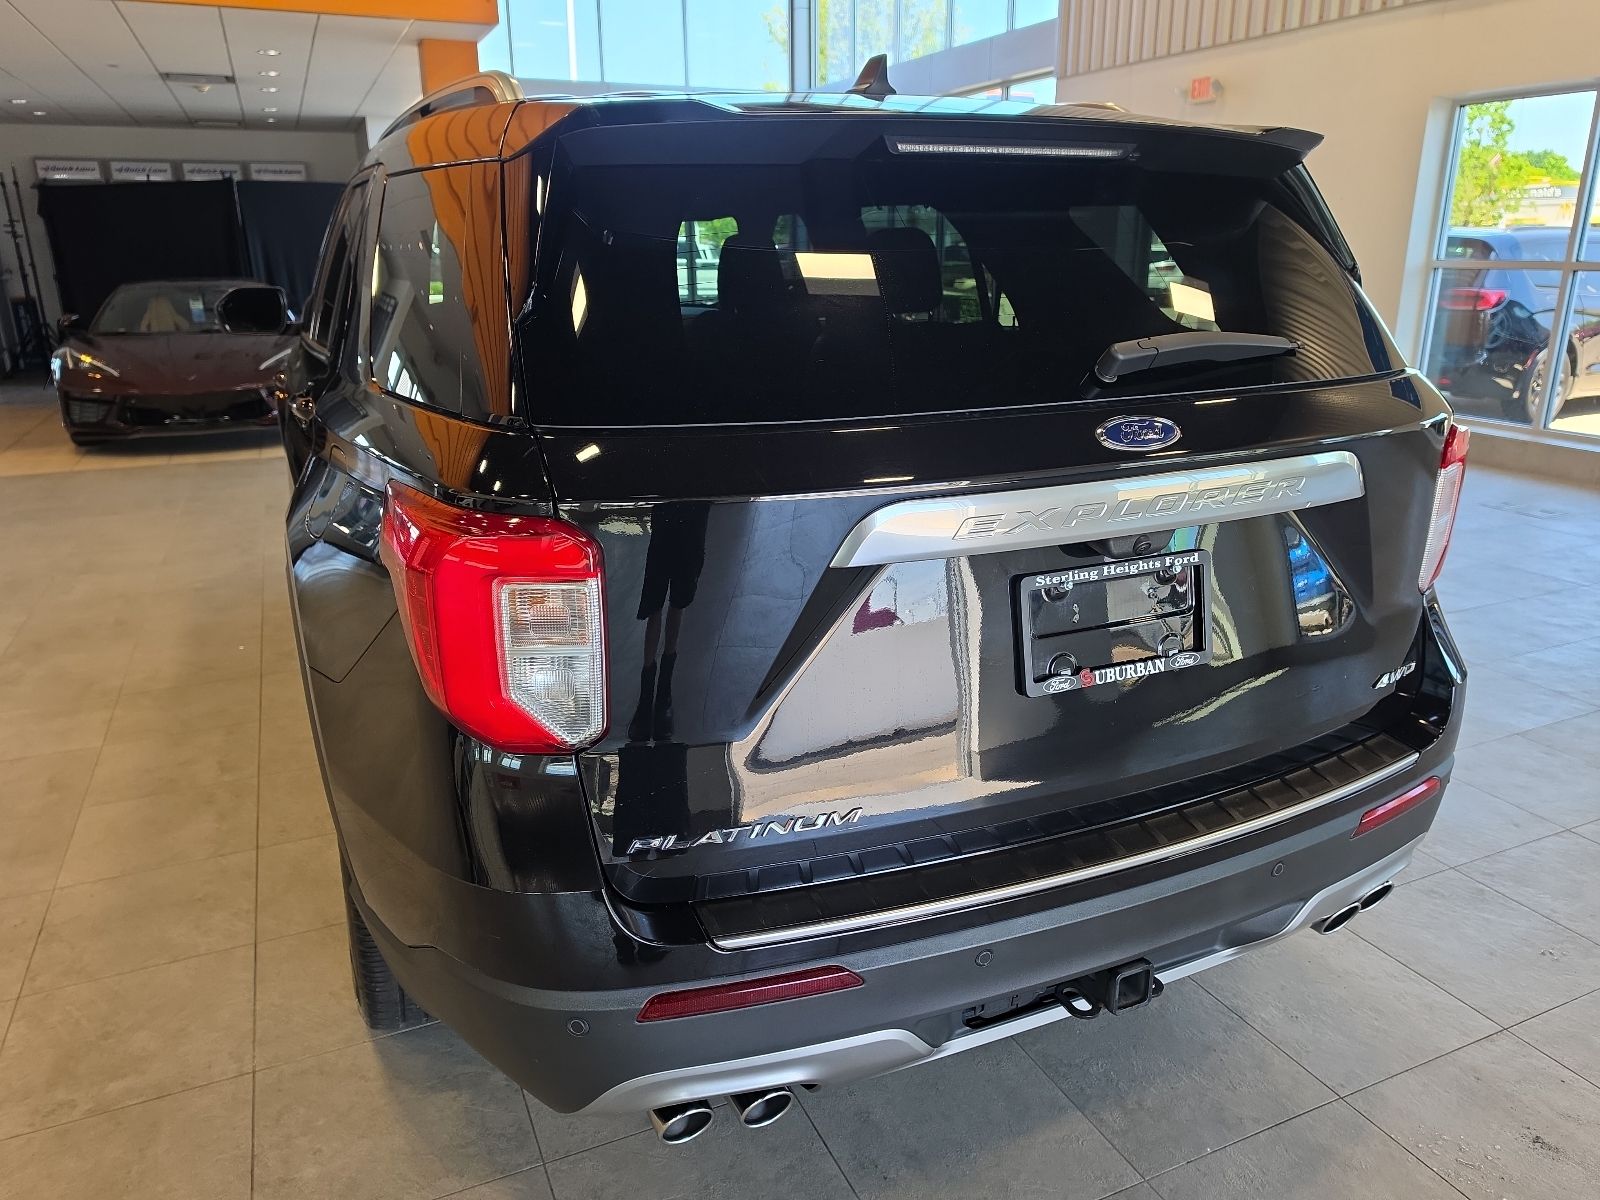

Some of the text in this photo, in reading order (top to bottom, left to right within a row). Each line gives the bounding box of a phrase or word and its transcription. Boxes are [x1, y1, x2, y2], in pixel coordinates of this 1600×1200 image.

[1120, 421, 1165, 442] Ford
[951, 476, 1307, 541] EXPLORER
[1035, 553, 1199, 586] Sterling Heights Ford
[1049, 654, 1198, 691] Ford SUBURBAN Ford
[627, 806, 863, 854] PLATINUM
